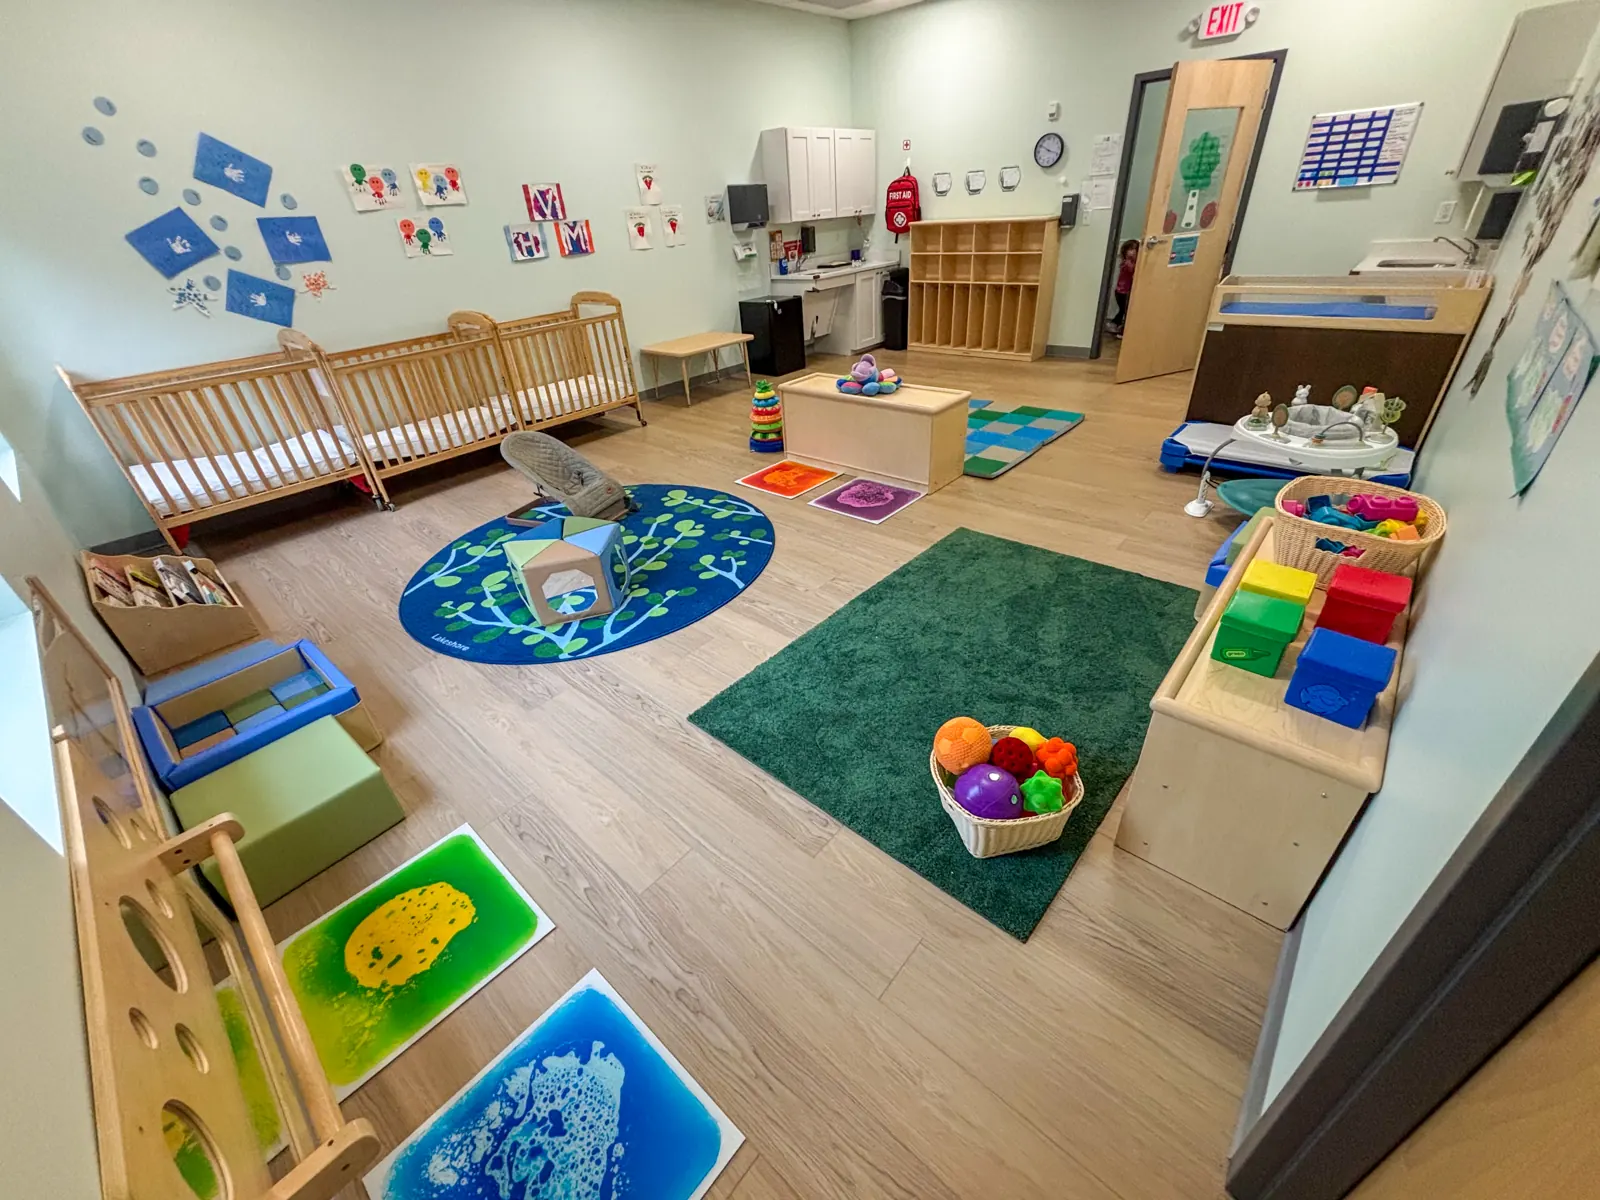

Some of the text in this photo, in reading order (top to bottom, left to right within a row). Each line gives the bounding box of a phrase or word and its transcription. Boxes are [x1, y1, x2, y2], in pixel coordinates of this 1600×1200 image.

[1205, 2, 1244, 36] EXIT
[889, 190, 912, 201] FIRST AID
[431, 633, 470, 651] Lakeshore
